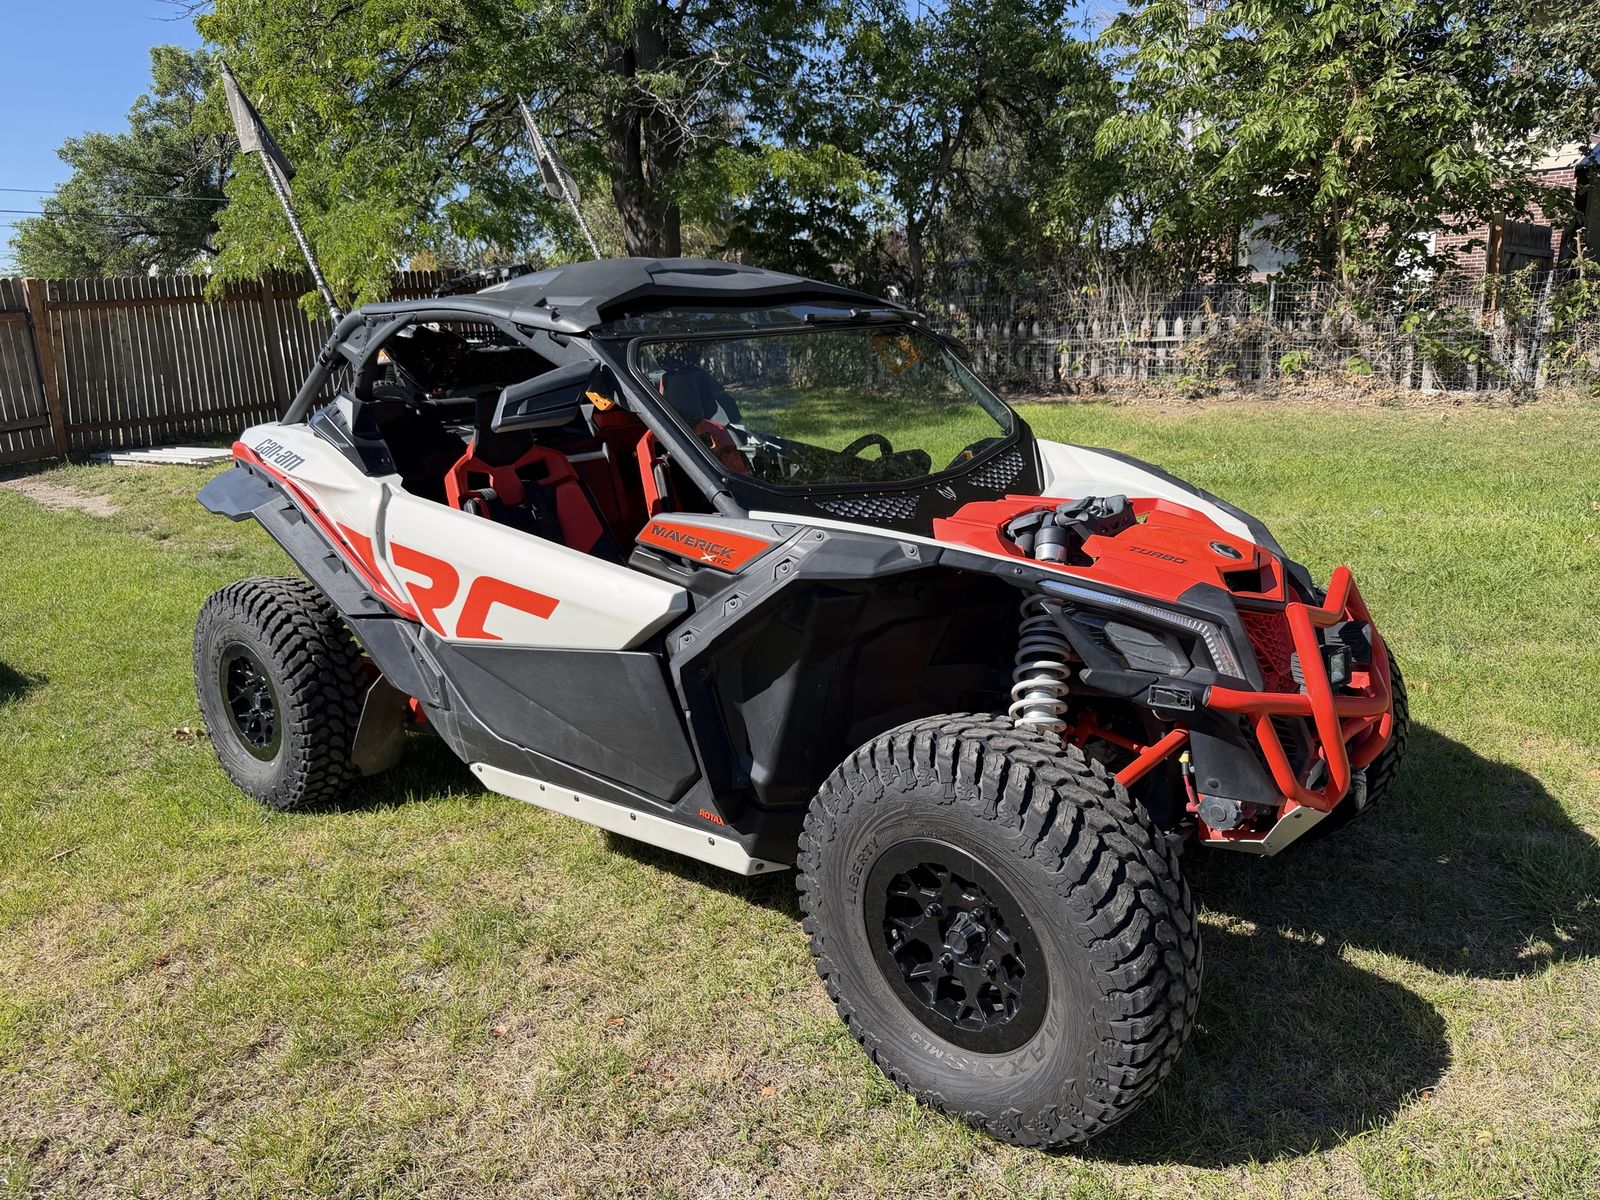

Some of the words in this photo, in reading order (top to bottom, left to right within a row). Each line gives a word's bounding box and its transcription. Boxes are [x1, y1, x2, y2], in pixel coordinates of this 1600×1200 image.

[651, 525, 735, 557] MAVERICK
[1130, 547, 1187, 564] TURBO
[846, 837, 880, 905] LIBERTY
